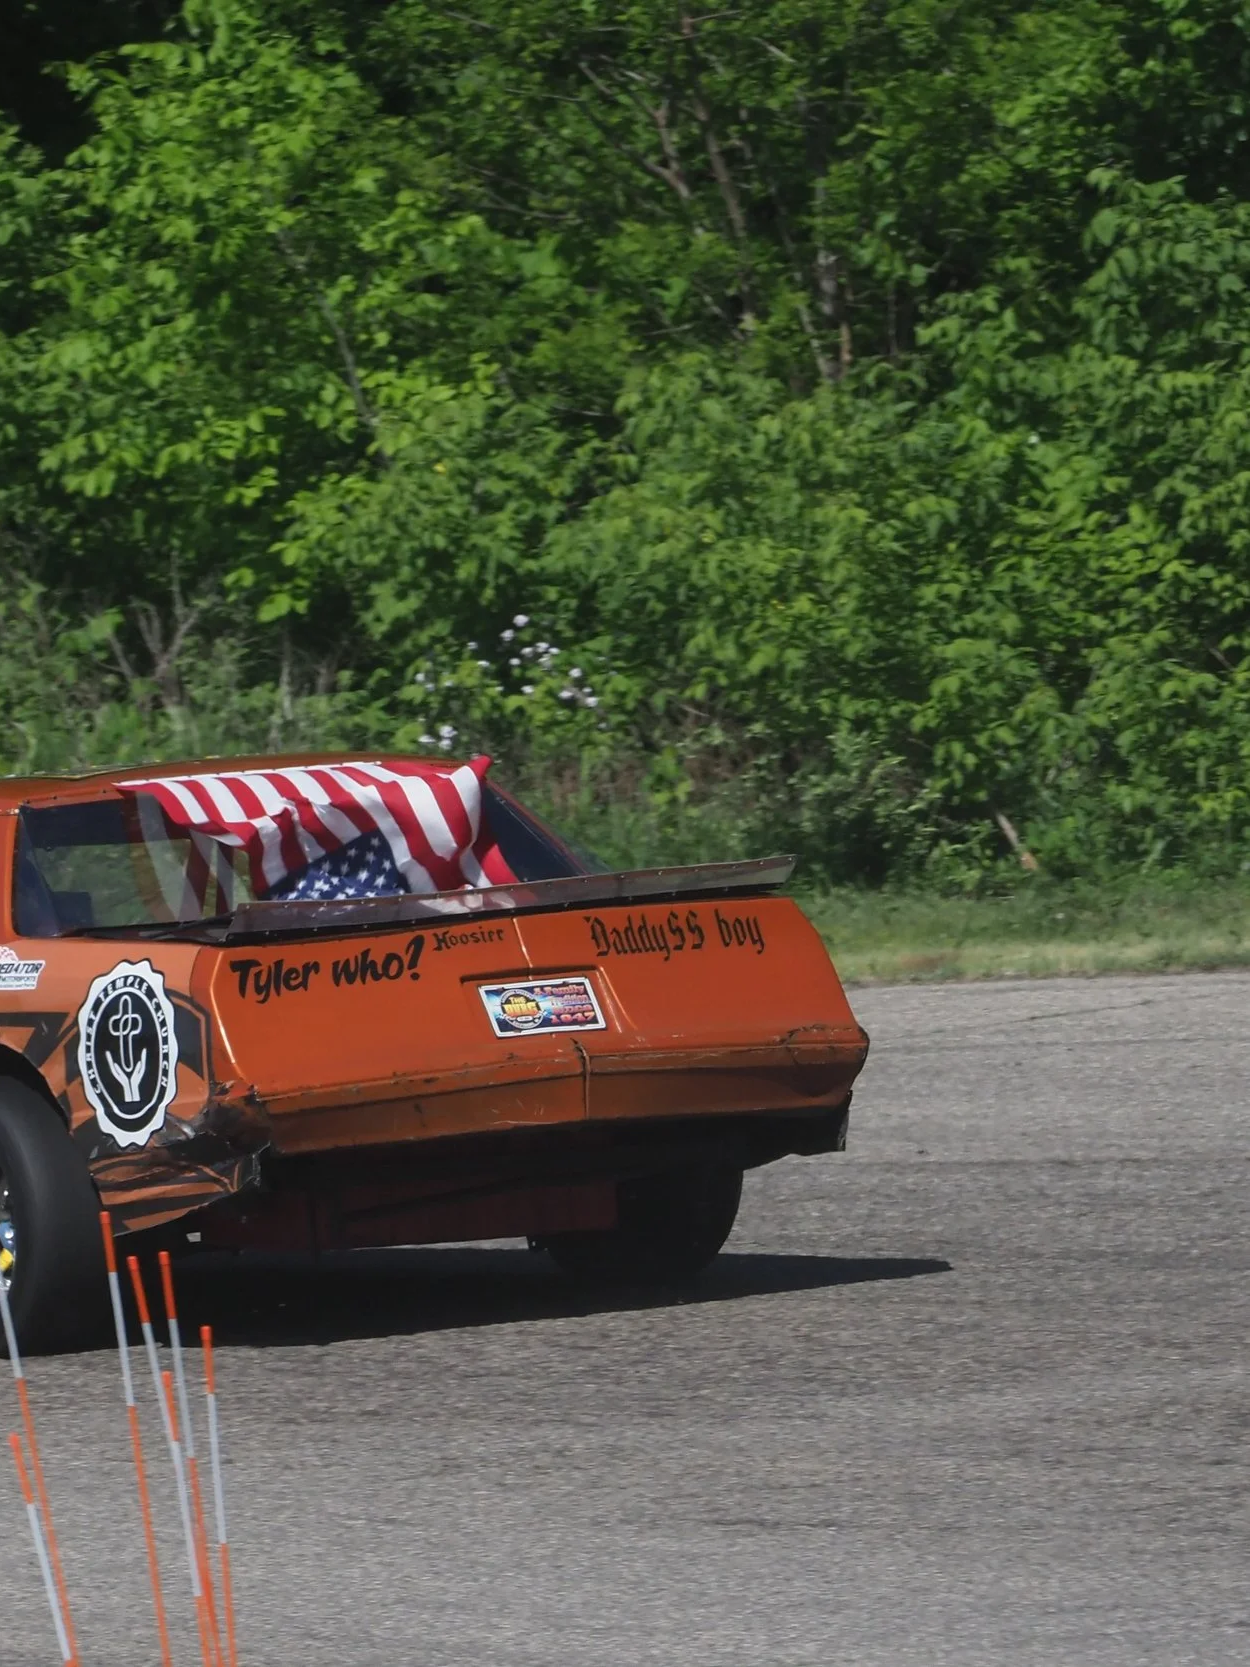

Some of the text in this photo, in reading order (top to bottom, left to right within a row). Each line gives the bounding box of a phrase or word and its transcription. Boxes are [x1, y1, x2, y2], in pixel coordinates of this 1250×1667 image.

[432, 926, 505, 951] Hoosier
[714, 908, 765, 955] boy
[229, 934, 426, 1004] Tyler who?
[85, 976, 170, 1094] CHRIST TEMPLE CHURCH
